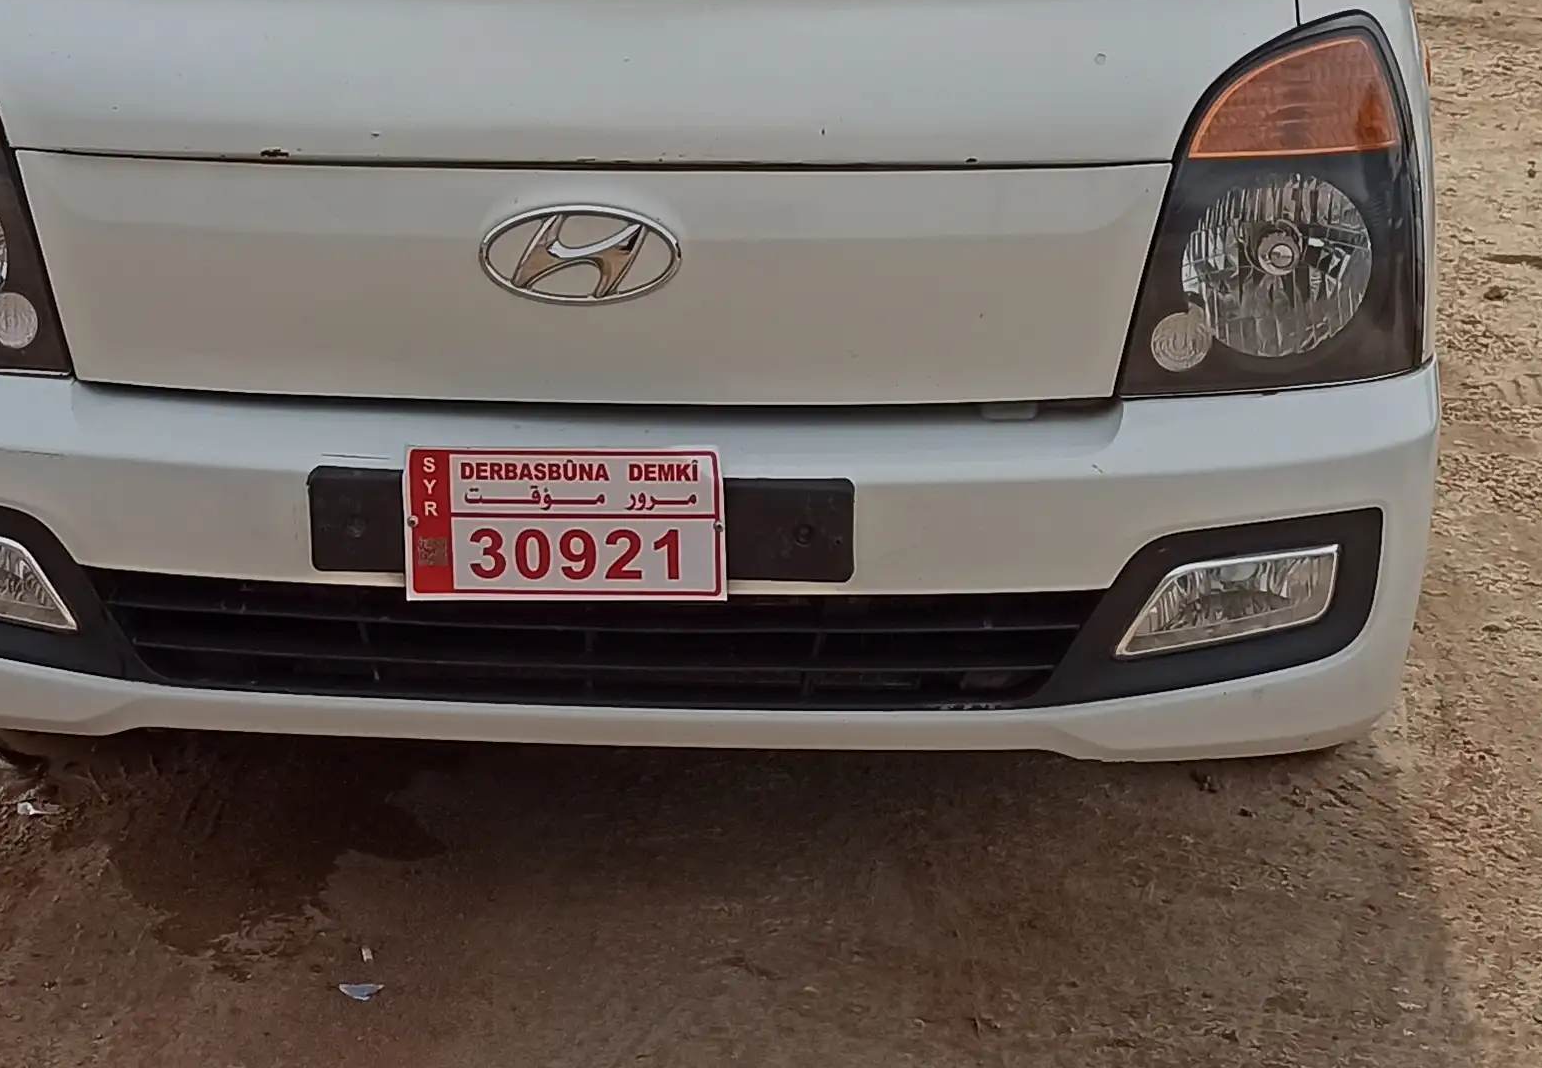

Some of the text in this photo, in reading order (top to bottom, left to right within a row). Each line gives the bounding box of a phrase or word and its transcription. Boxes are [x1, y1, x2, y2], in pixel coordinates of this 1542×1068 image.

[423, 457, 438, 517] SYR
[460, 459, 698, 482] DERBASBÛNA DEMKÎ
[624, 489, 697, 511] مرور
[469, 527, 680, 580] 30921
